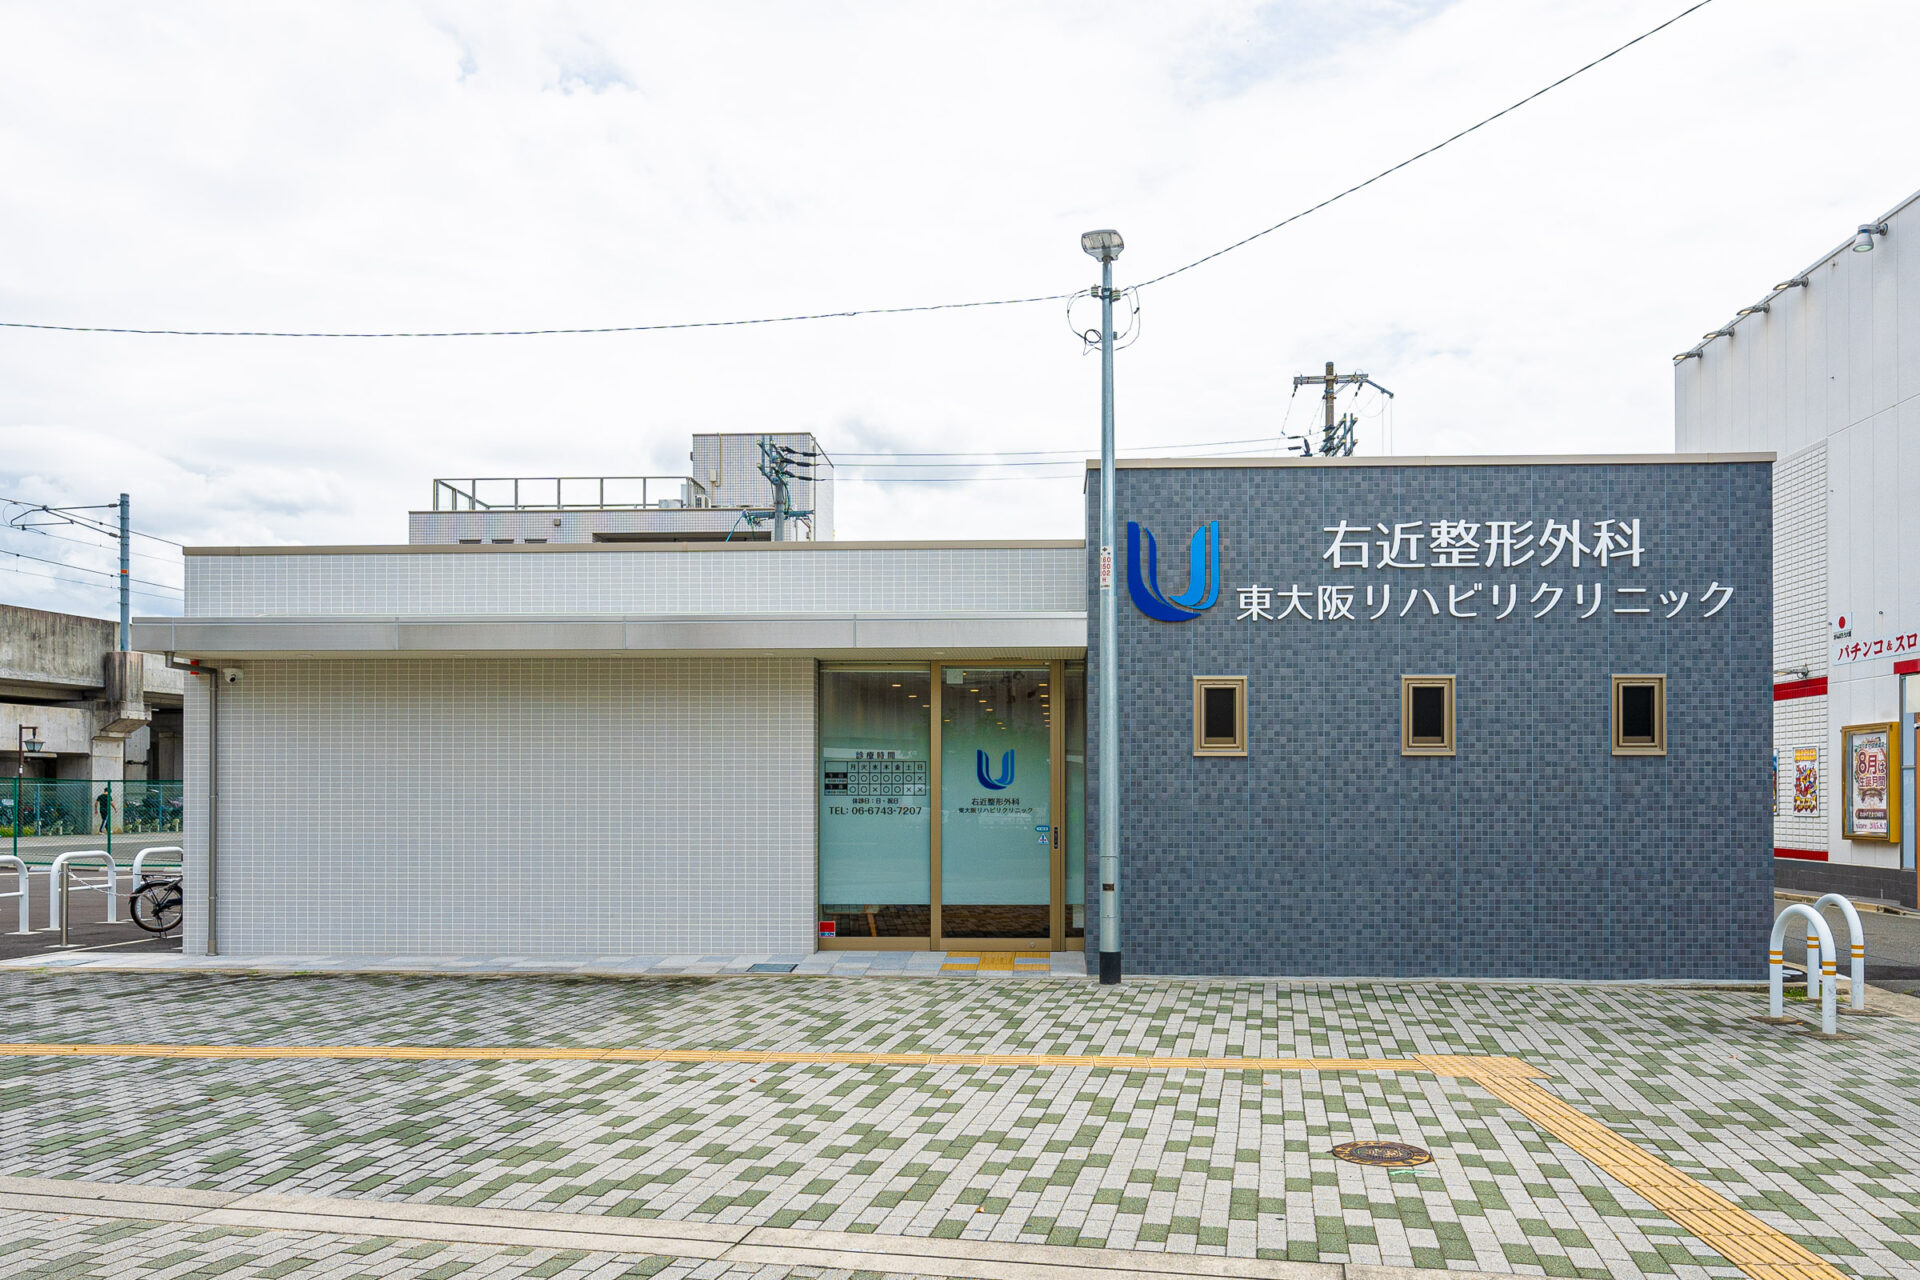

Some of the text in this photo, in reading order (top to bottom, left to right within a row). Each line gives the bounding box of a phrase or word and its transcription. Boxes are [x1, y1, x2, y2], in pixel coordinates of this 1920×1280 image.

[1322, 518, 1646, 570] 右近整形外科
[1236, 581, 1735, 622] 東大阪リハビリクリニック
[855, 751, 896, 760] 診療時間
[850, 763, 856, 771] 月
[860, 763, 868, 771] 火
[906, 763, 912, 771] 土
[916, 763, 923, 771] 日
[971, 798, 1020, 806] 右近整形外科
[829, 806, 922, 815] TEL: 06-6743-7207
